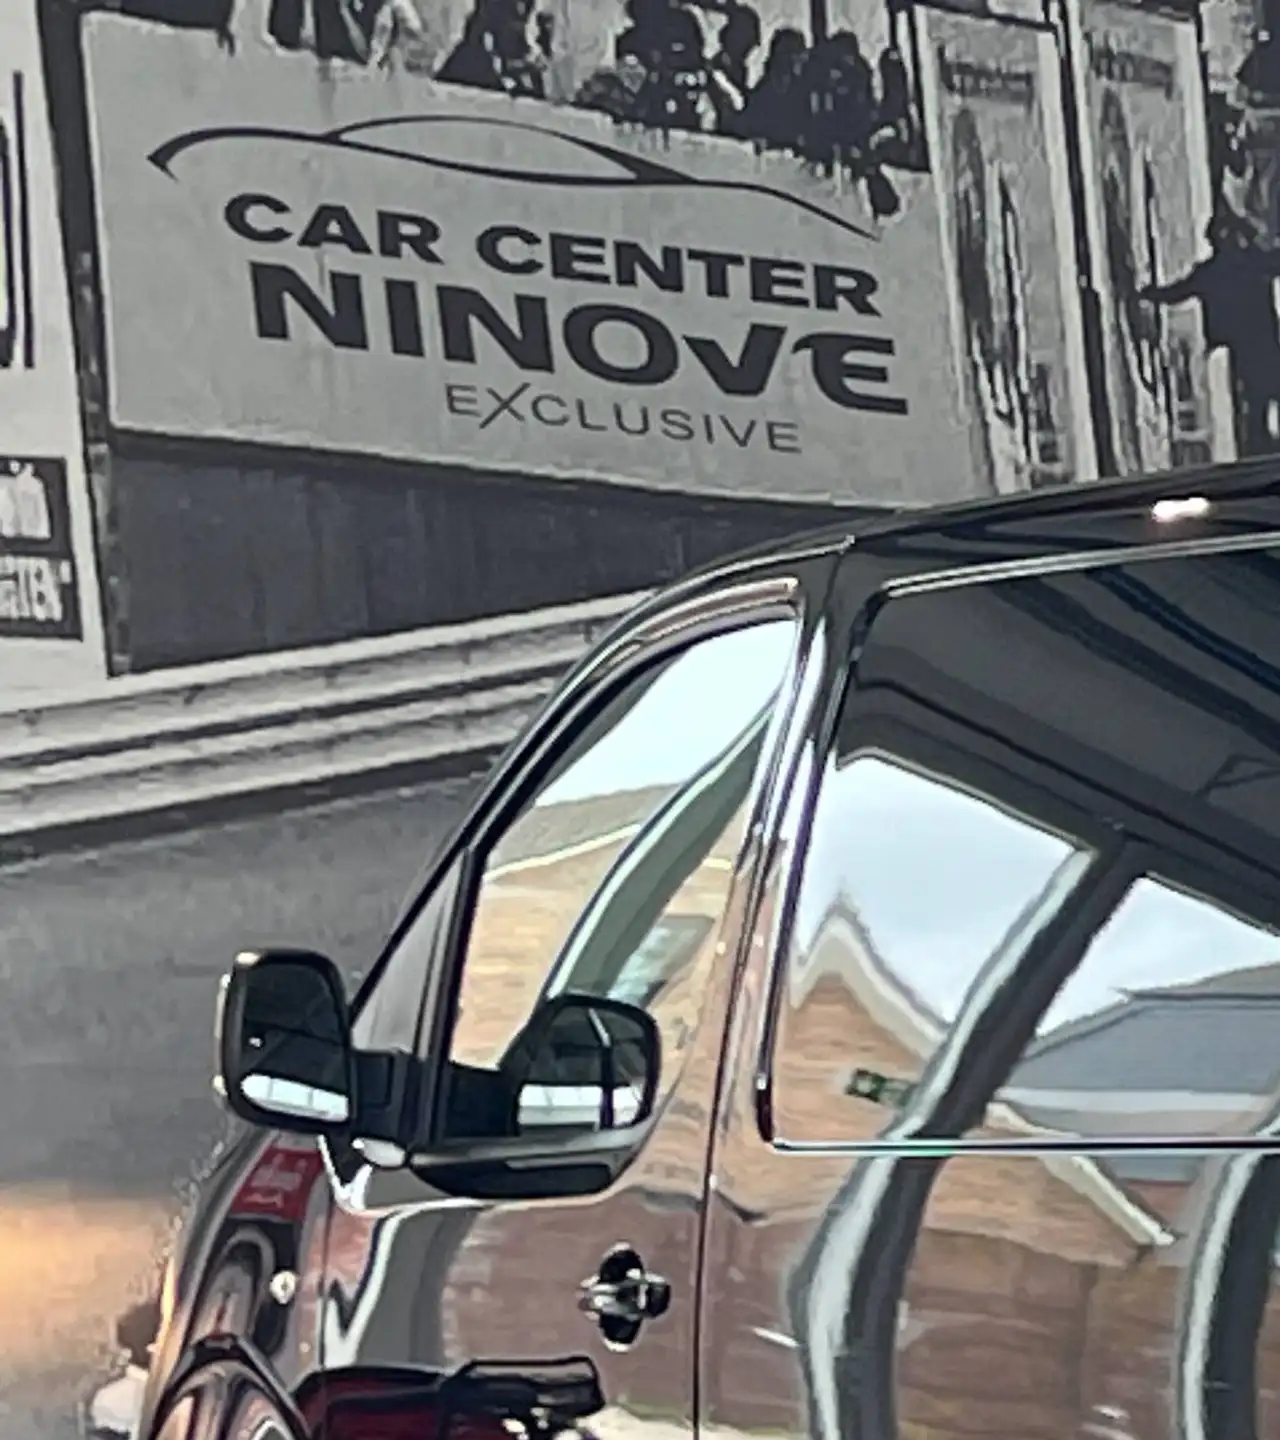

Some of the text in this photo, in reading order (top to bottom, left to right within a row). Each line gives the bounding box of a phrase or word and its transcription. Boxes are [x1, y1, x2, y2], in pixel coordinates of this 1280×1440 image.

[224, 192, 881, 318] CAR CENTER
[247, 260, 910, 415] NINOVE
[445, 382, 804, 454] EXCLUSIVE
